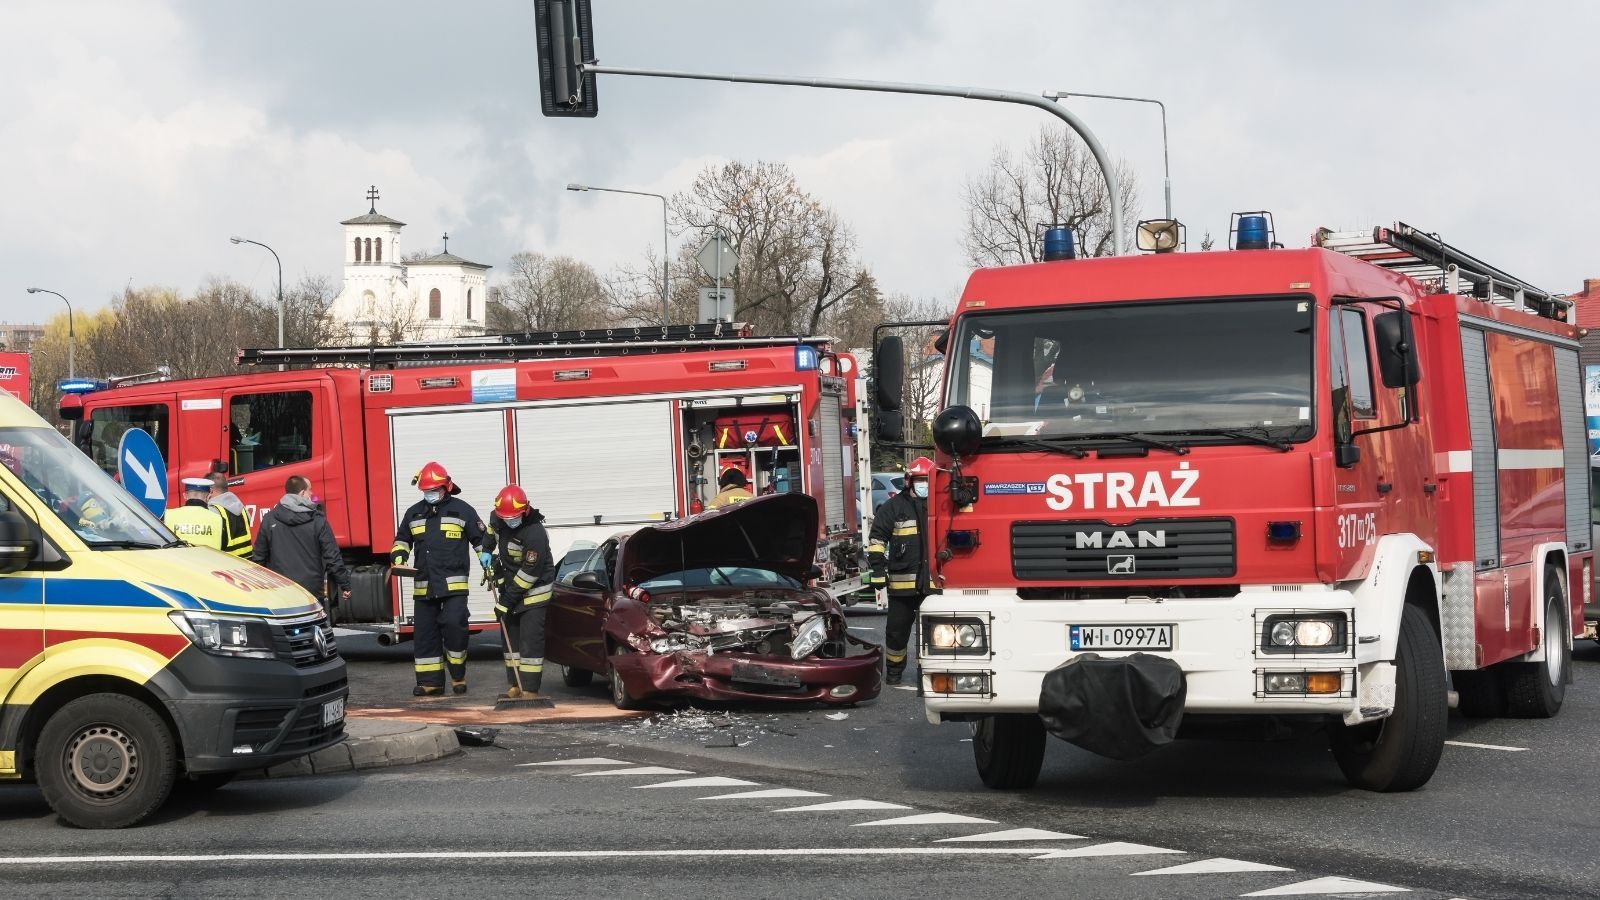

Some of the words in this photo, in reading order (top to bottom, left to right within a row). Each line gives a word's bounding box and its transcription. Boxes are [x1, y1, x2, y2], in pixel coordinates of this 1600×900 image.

[1046, 461, 1200, 511] STRAŻ
[174, 524, 213, 536] POLICJA
[1075, 530, 1166, 549] MAN
[1338, 514, 1357, 548] 317
[1365, 512, 1376, 546] 25
[1113, 628, 1167, 646] 0997A
